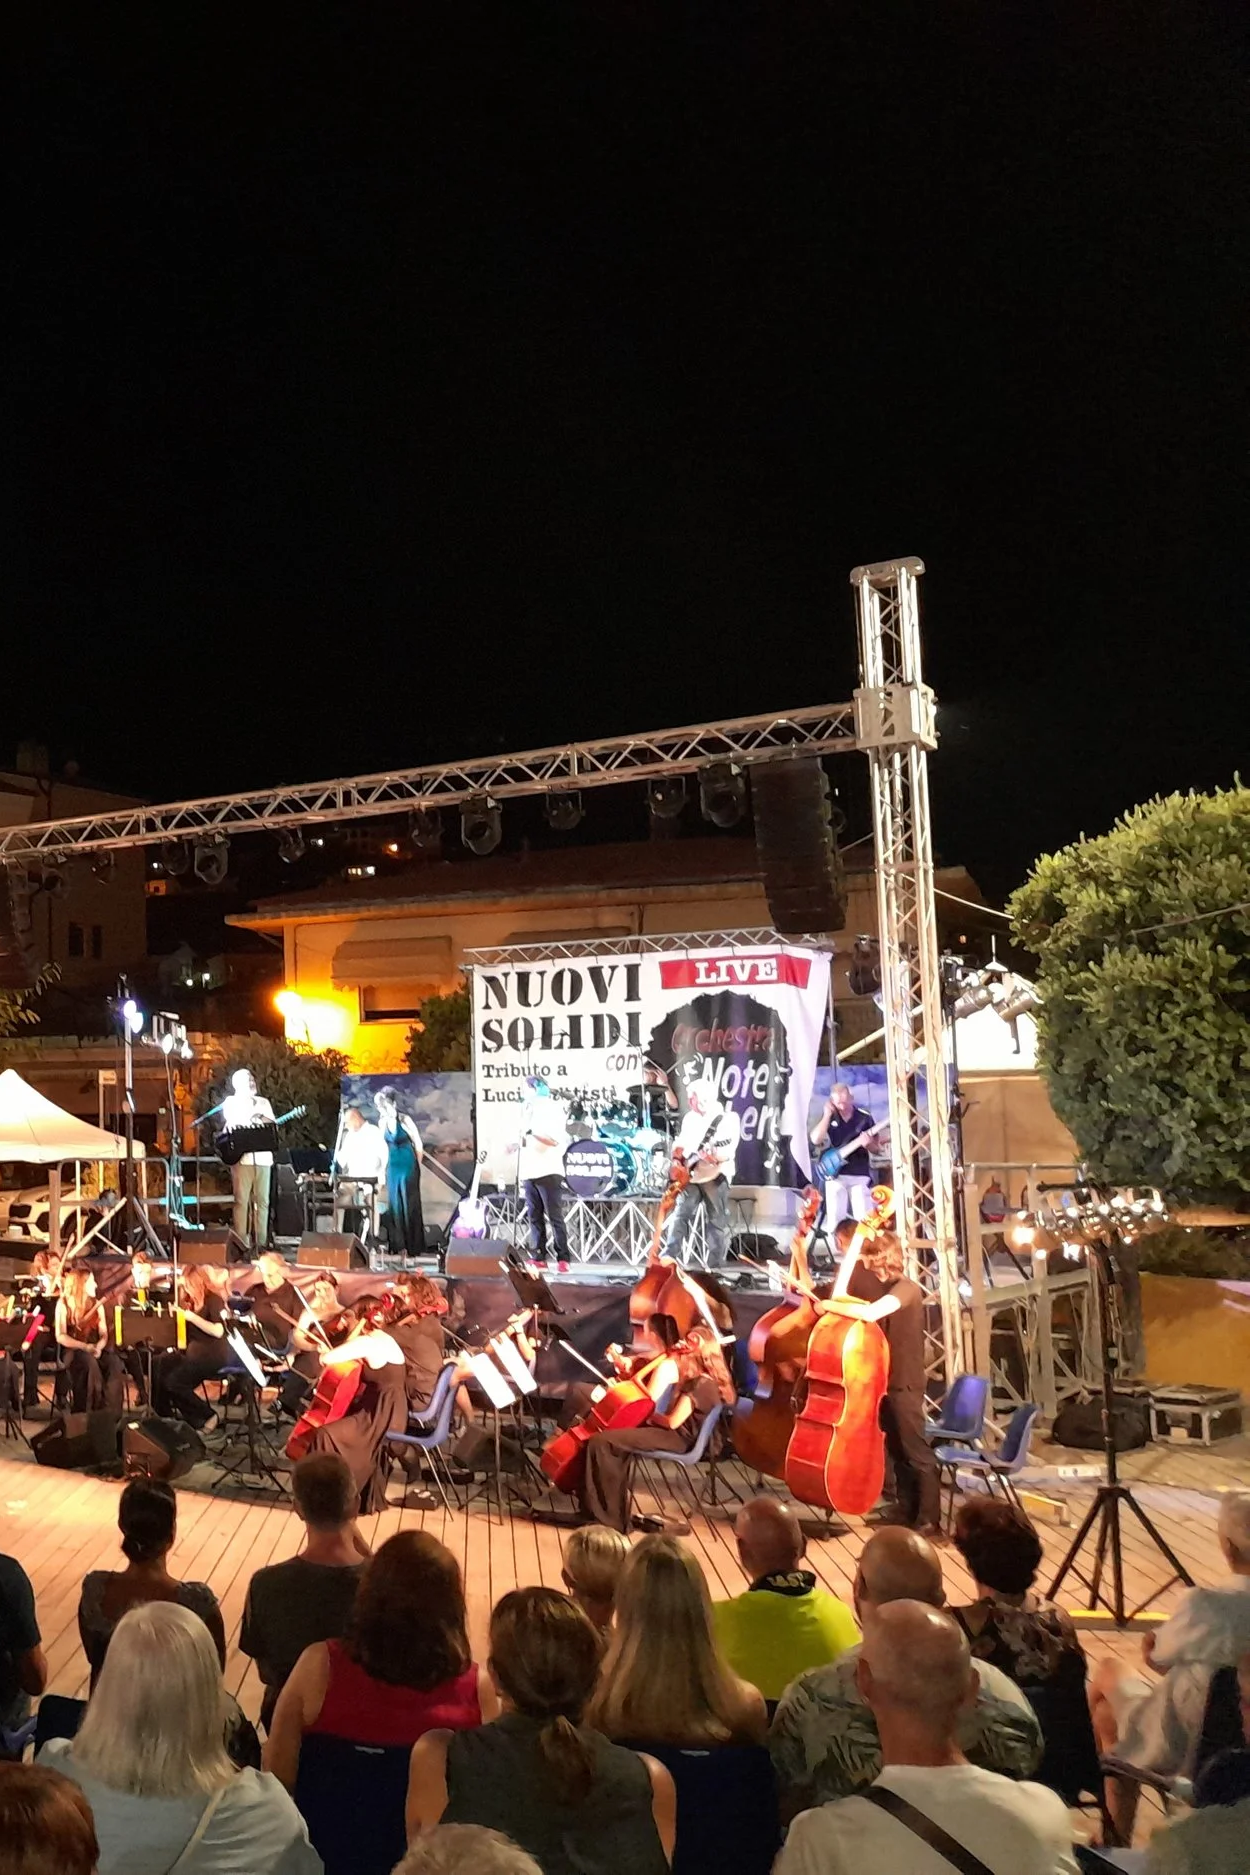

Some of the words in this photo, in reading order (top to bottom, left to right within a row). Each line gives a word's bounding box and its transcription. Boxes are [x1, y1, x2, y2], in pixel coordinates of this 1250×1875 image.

[694, 958, 778, 984] LIVE
[481, 963, 642, 1010] NUOVI
[481, 1012, 642, 1053] SOLIDI
[482, 1063, 551, 1078] Tributo
[557, 1064, 568, 1076] a
[606, 1053, 638, 1071] con
[700, 1057, 770, 1099] Note
[482, 1087, 525, 1103] Luci
